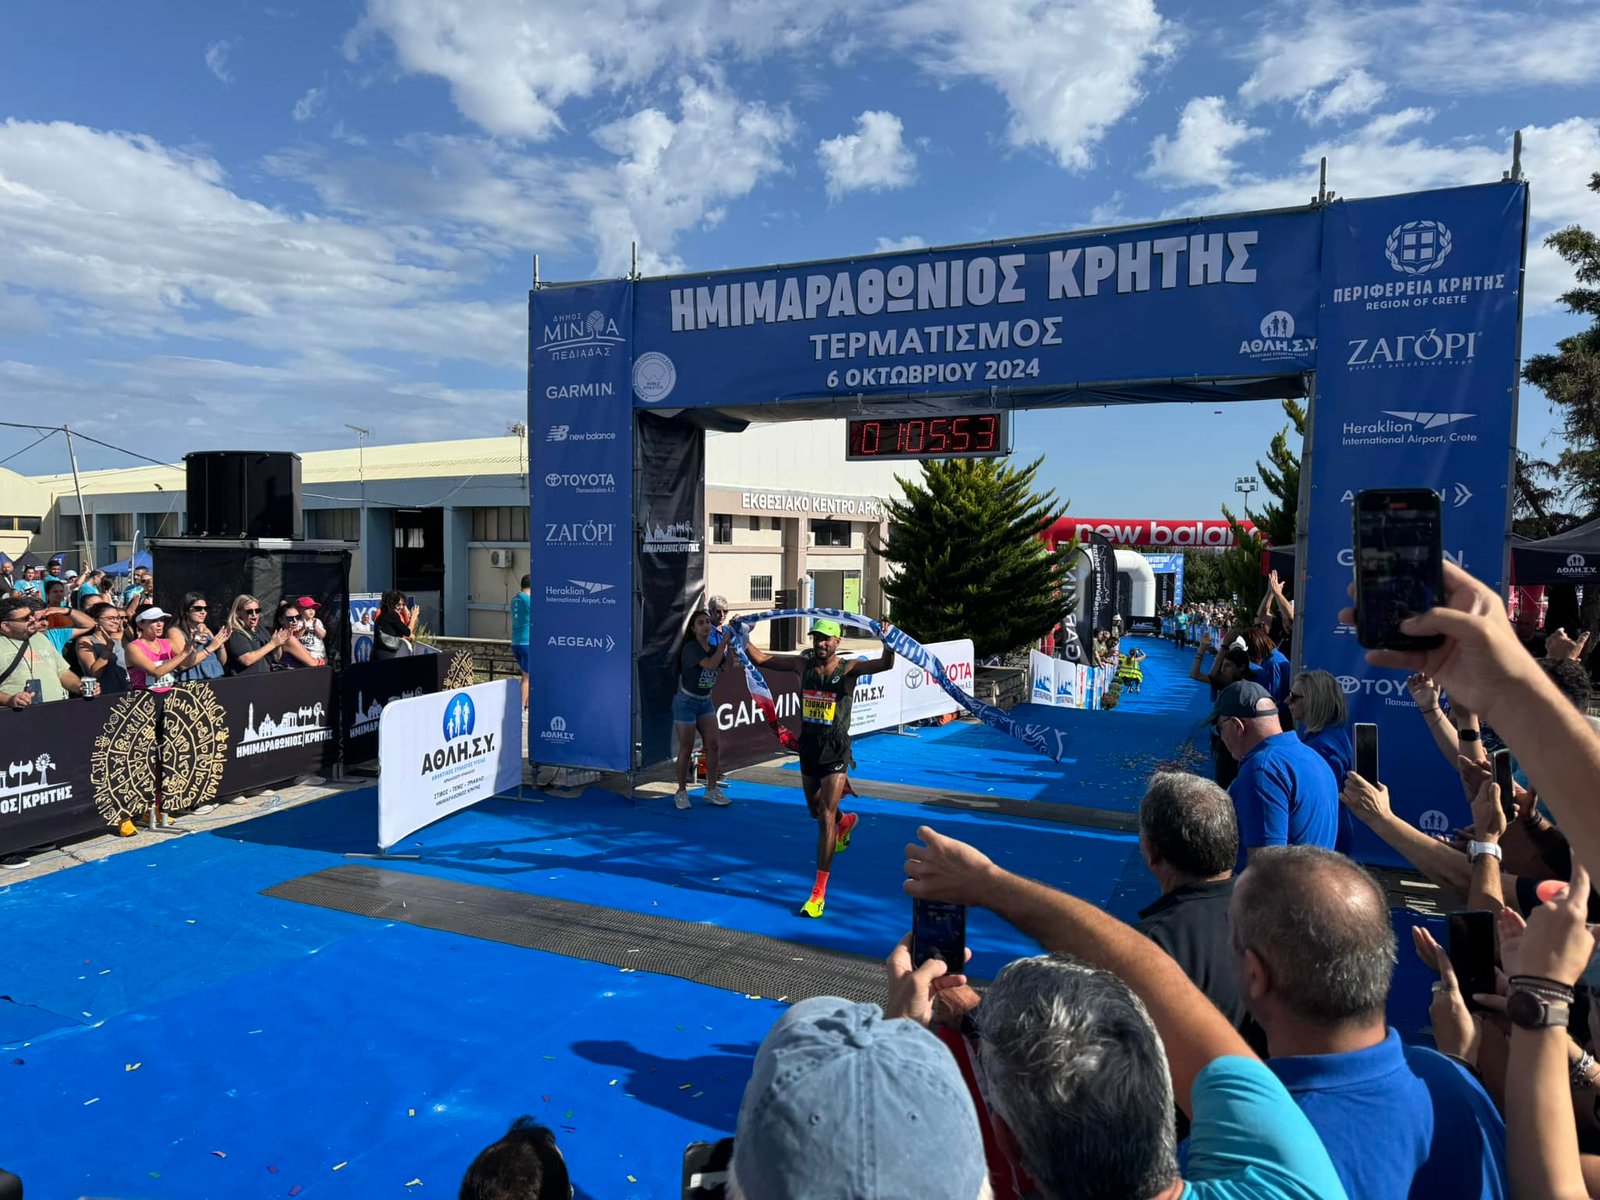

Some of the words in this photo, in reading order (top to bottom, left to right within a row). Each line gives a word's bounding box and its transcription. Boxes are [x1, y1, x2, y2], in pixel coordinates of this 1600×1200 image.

[670, 253, 1027, 332] ΗΜΙΜΑΡΑΘΩΝΙΟΣ
[1048, 230, 1260, 300] ΚΡΗΤΗΣ
[1333, 279, 1433, 302] ΠΕΡΙΦΕΡΕΙΑ
[1438, 273, 1505, 294] ΚΡΗΤΗΣ
[1366, 297, 1410, 311] REGION
[1413, 297, 1428, 307] OF
[1432, 294, 1468, 305] CRETE
[809, 316, 1063, 361] ΤΕΡΜΑΤΙΣΜΟΣ
[552, 347, 612, 361] ΠΕΔΙΑΔΑΣ
[826, 370, 839, 388] 6
[845, 361, 978, 387] ΟΚΤΩΒΡΙΟΥ
[984, 357, 1040, 381] 2024
[546, 381, 613, 399] GARMIN
[1343, 419, 1413, 434] Heraklion
[586, 432, 616, 440] balance
[1342, 434, 1404, 446] International
[1407, 434, 1446, 446] Airport,
[1449, 432, 1477, 442] Crete
[561, 473, 615, 486] TOYOTA
[742, 492, 809, 512] ΕΚΘΕΣΙΑΚΟ
[812, 497, 855, 514] ΚΕΝΤΡΟ
[545, 585, 585, 595] Heraklion
[547, 635, 603, 648] AEGEAN
[236, 734, 303, 758] ΗΜΙΜΑΡΑΘΩΝΙΟΣ
[305, 729, 333, 744] ΚΡΗΤΗΣ
[22, 785, 73, 810] ΚΡΗΤΗΣ
